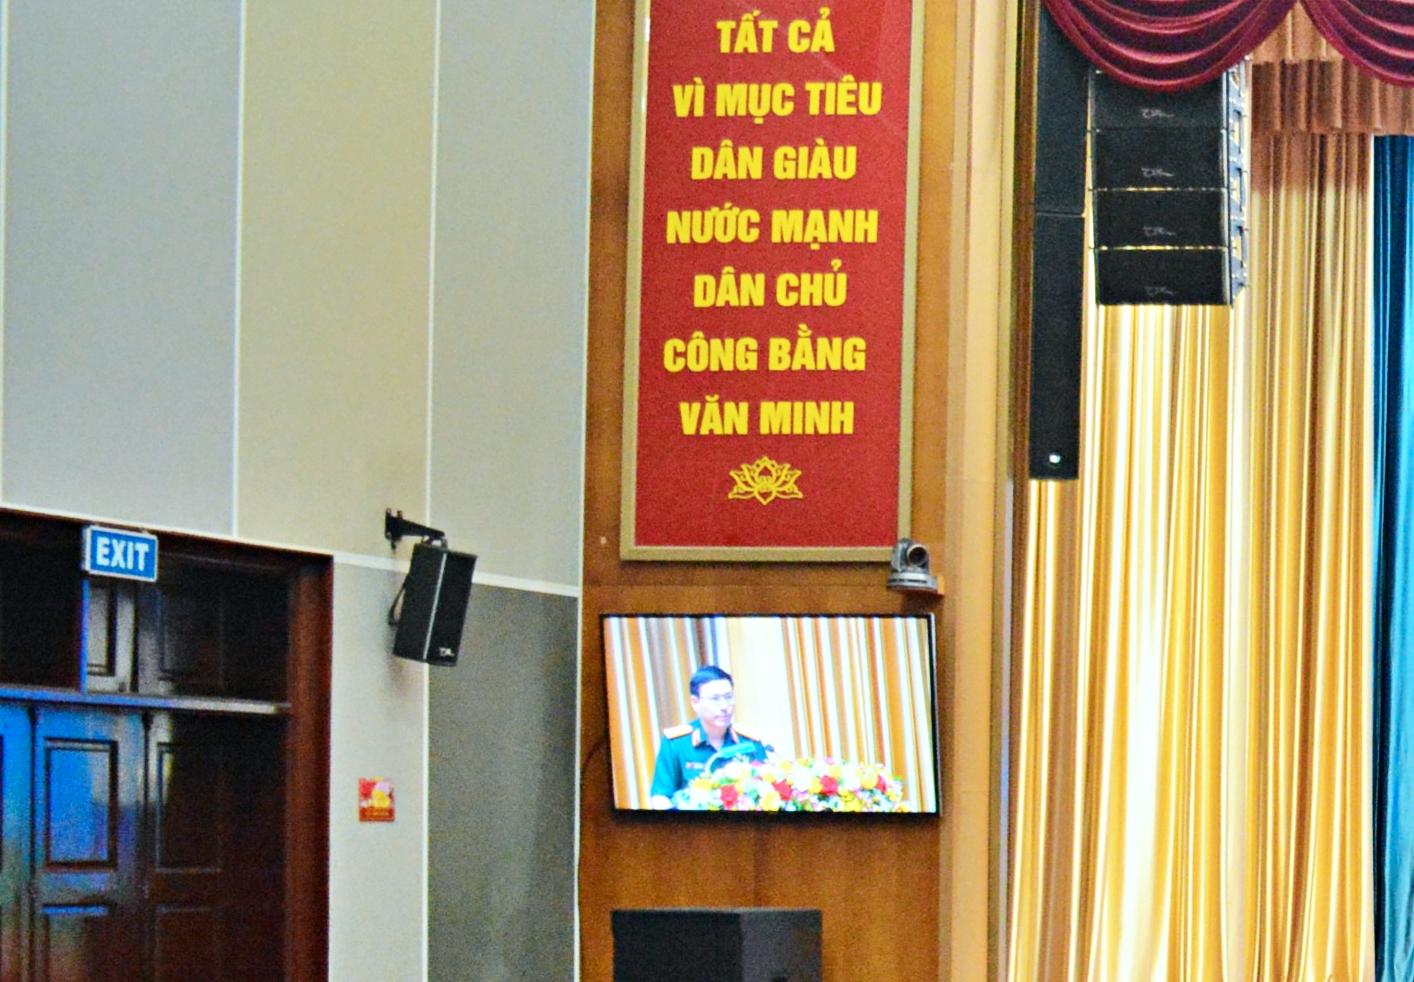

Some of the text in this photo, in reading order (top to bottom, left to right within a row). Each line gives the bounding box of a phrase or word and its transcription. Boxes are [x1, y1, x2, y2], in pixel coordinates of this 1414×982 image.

[717, 7, 834, 53] TẤT CẢ
[673, 75, 882, 124] VÌ MỤC TIÊU
[692, 138, 856, 179] DÂN GIÀU
[667, 203, 878, 249] NƯỚC MẠNH
[694, 259, 846, 307] DÂN CHỦ
[664, 324, 866, 372] CÔNG BẰNG
[680, 395, 854, 434] VĂN MINH
[96, 536, 149, 571] EXIT
